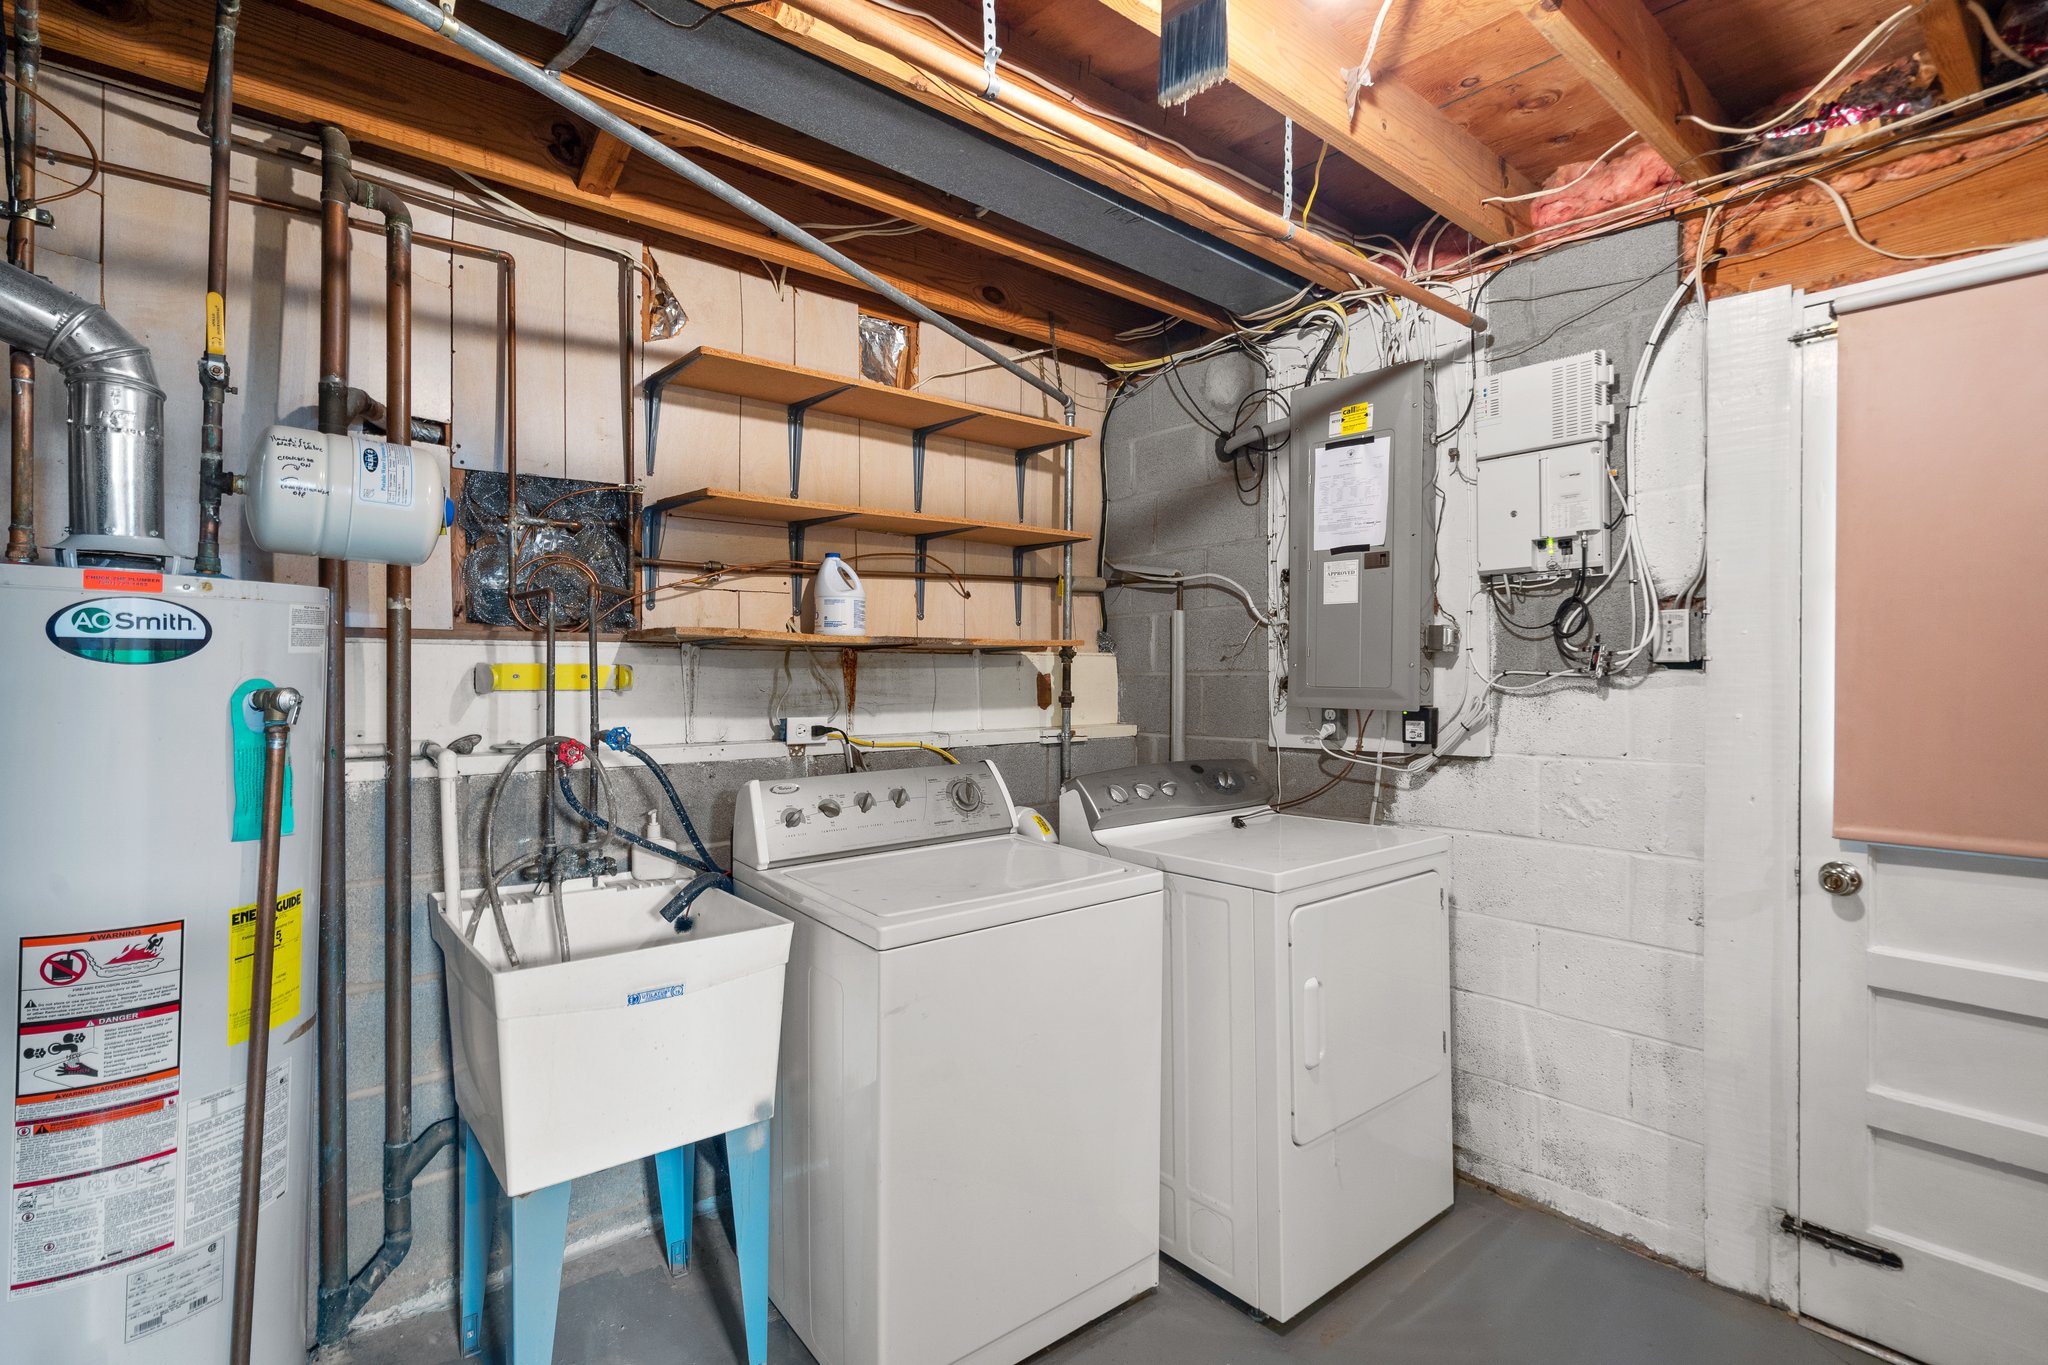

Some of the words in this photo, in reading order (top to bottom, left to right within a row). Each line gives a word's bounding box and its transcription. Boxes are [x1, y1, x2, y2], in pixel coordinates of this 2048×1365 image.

[1343, 406, 1356, 415] call
[116, 613, 192, 630] Smith
[97, 930, 142, 941] WARNING
[99, 1012, 138, 1024] DANGER
[61, 1089, 94, 1098] WARNING
[100, 1078, 147, 1091] ADVERTENCIA
